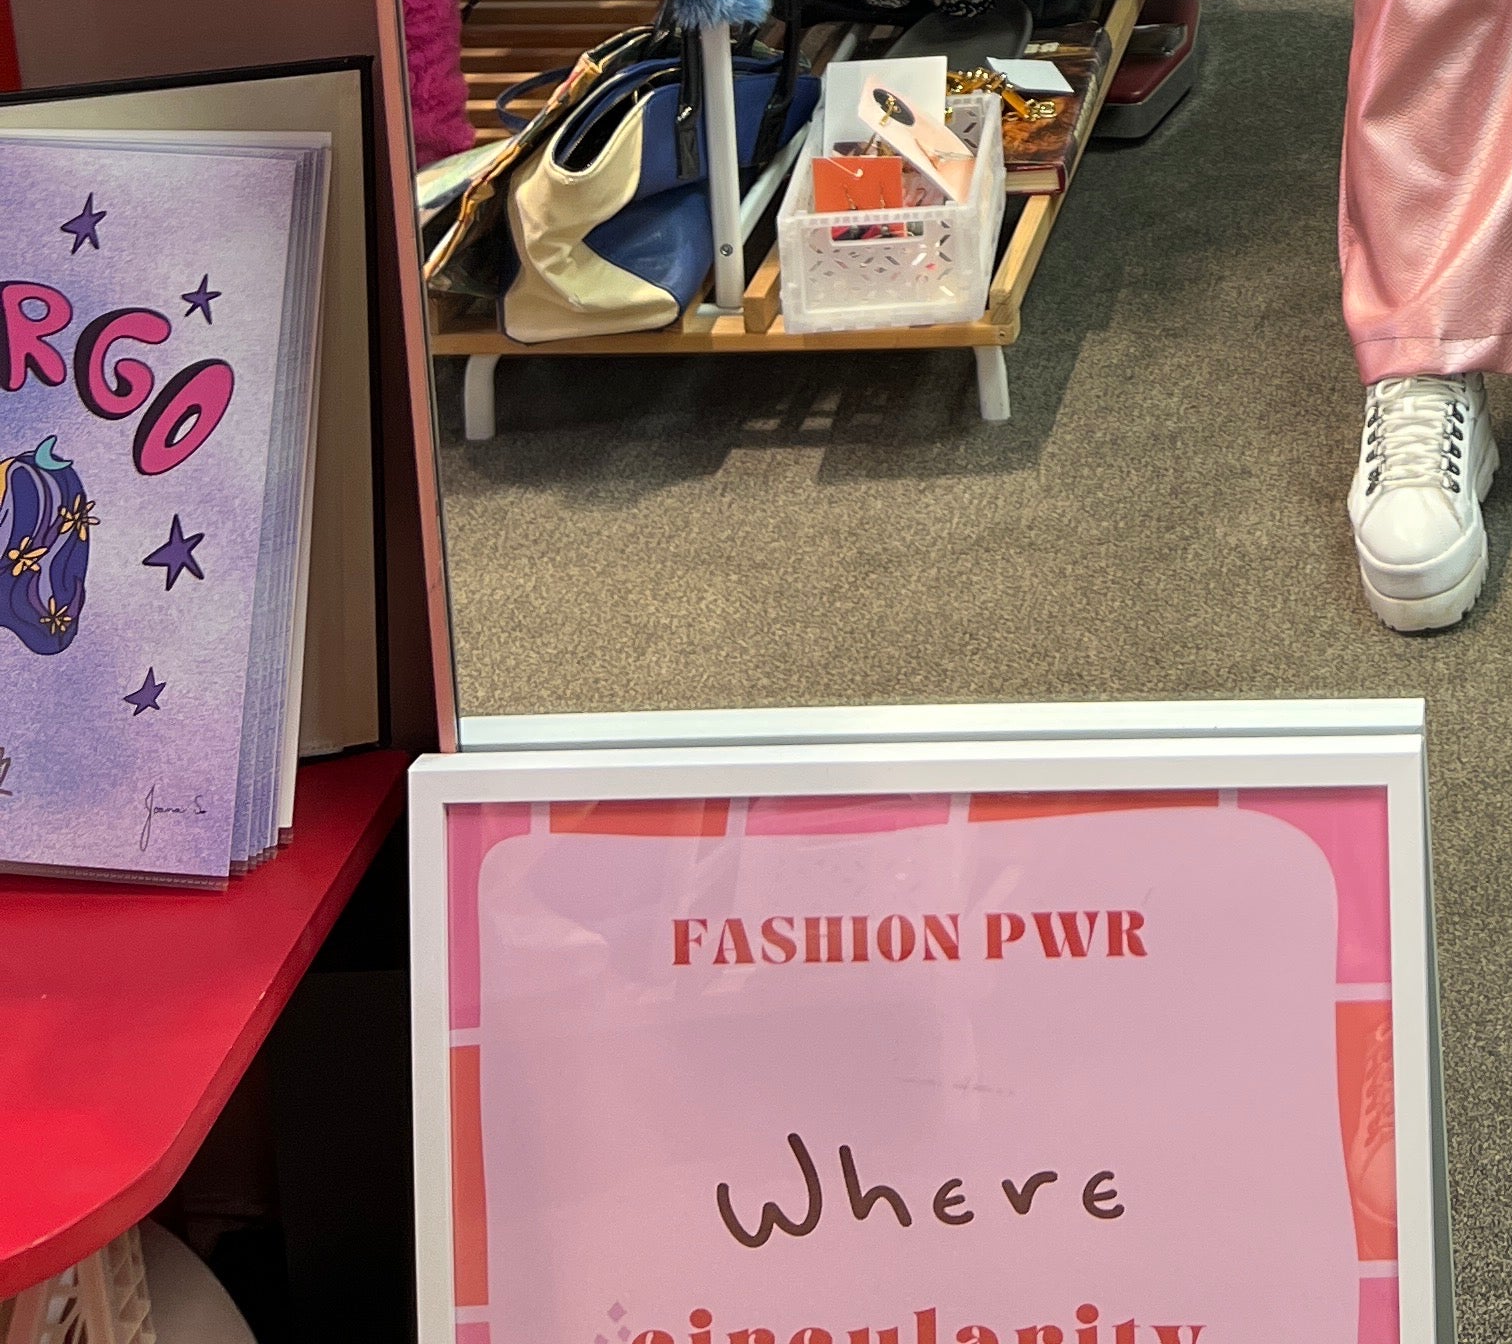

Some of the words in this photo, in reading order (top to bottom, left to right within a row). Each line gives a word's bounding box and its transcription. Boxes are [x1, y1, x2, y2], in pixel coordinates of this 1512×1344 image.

[670, 912, 962, 967] FASHION
[984, 909, 1148, 961] PWR
[716, 1133, 1126, 1249] Where
